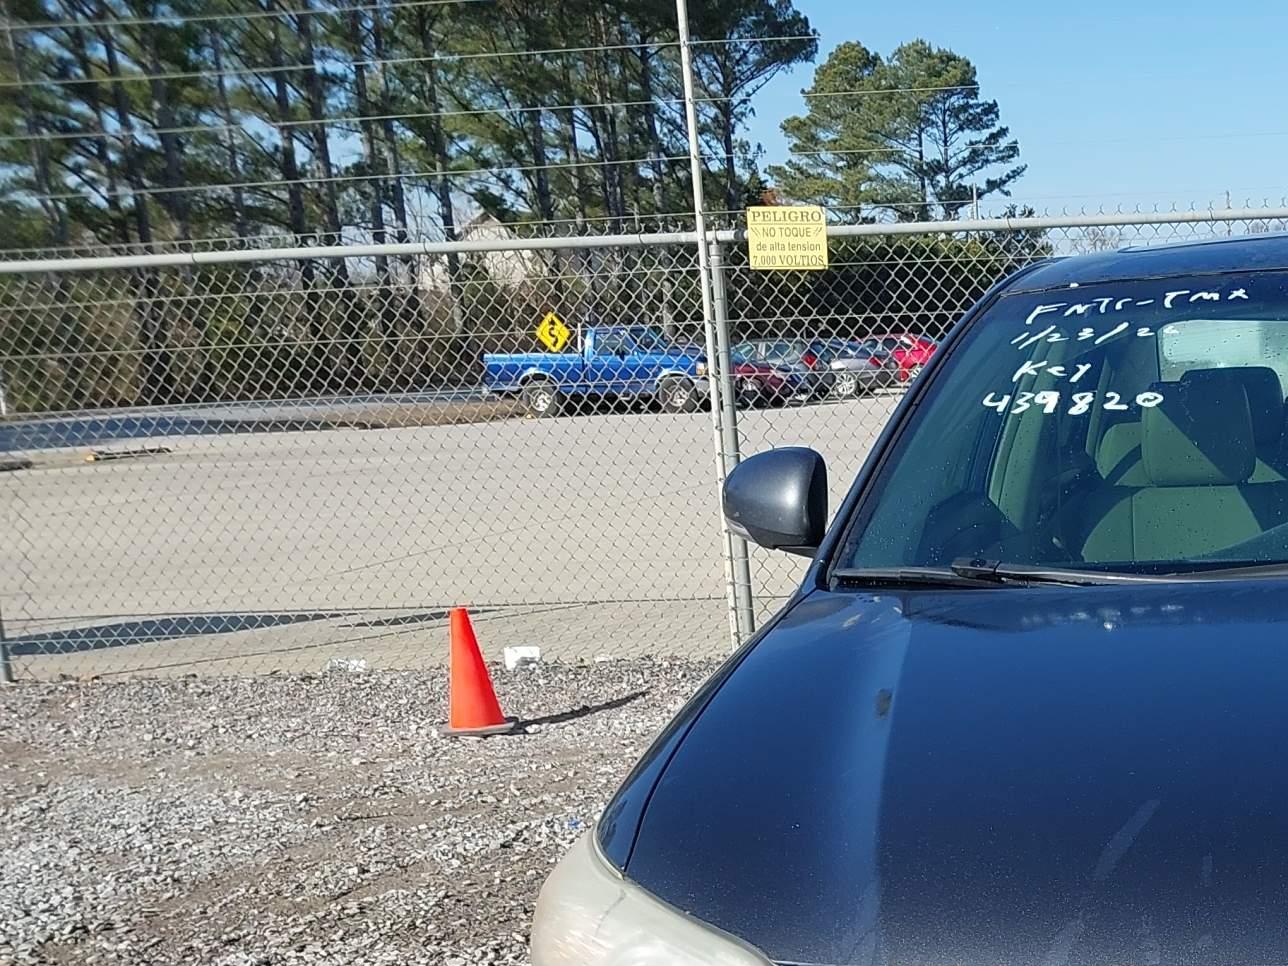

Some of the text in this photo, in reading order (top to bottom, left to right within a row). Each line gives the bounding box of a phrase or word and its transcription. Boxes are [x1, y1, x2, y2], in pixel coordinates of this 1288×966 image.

[751, 211, 822, 222] PELIGRO
[762, 227, 812, 237] NO TOQUE
[756, 241, 821, 251] de alta tension
[779, 255, 824, 266] VOLTIOS
[982, 391, 1163, 415] 439820
